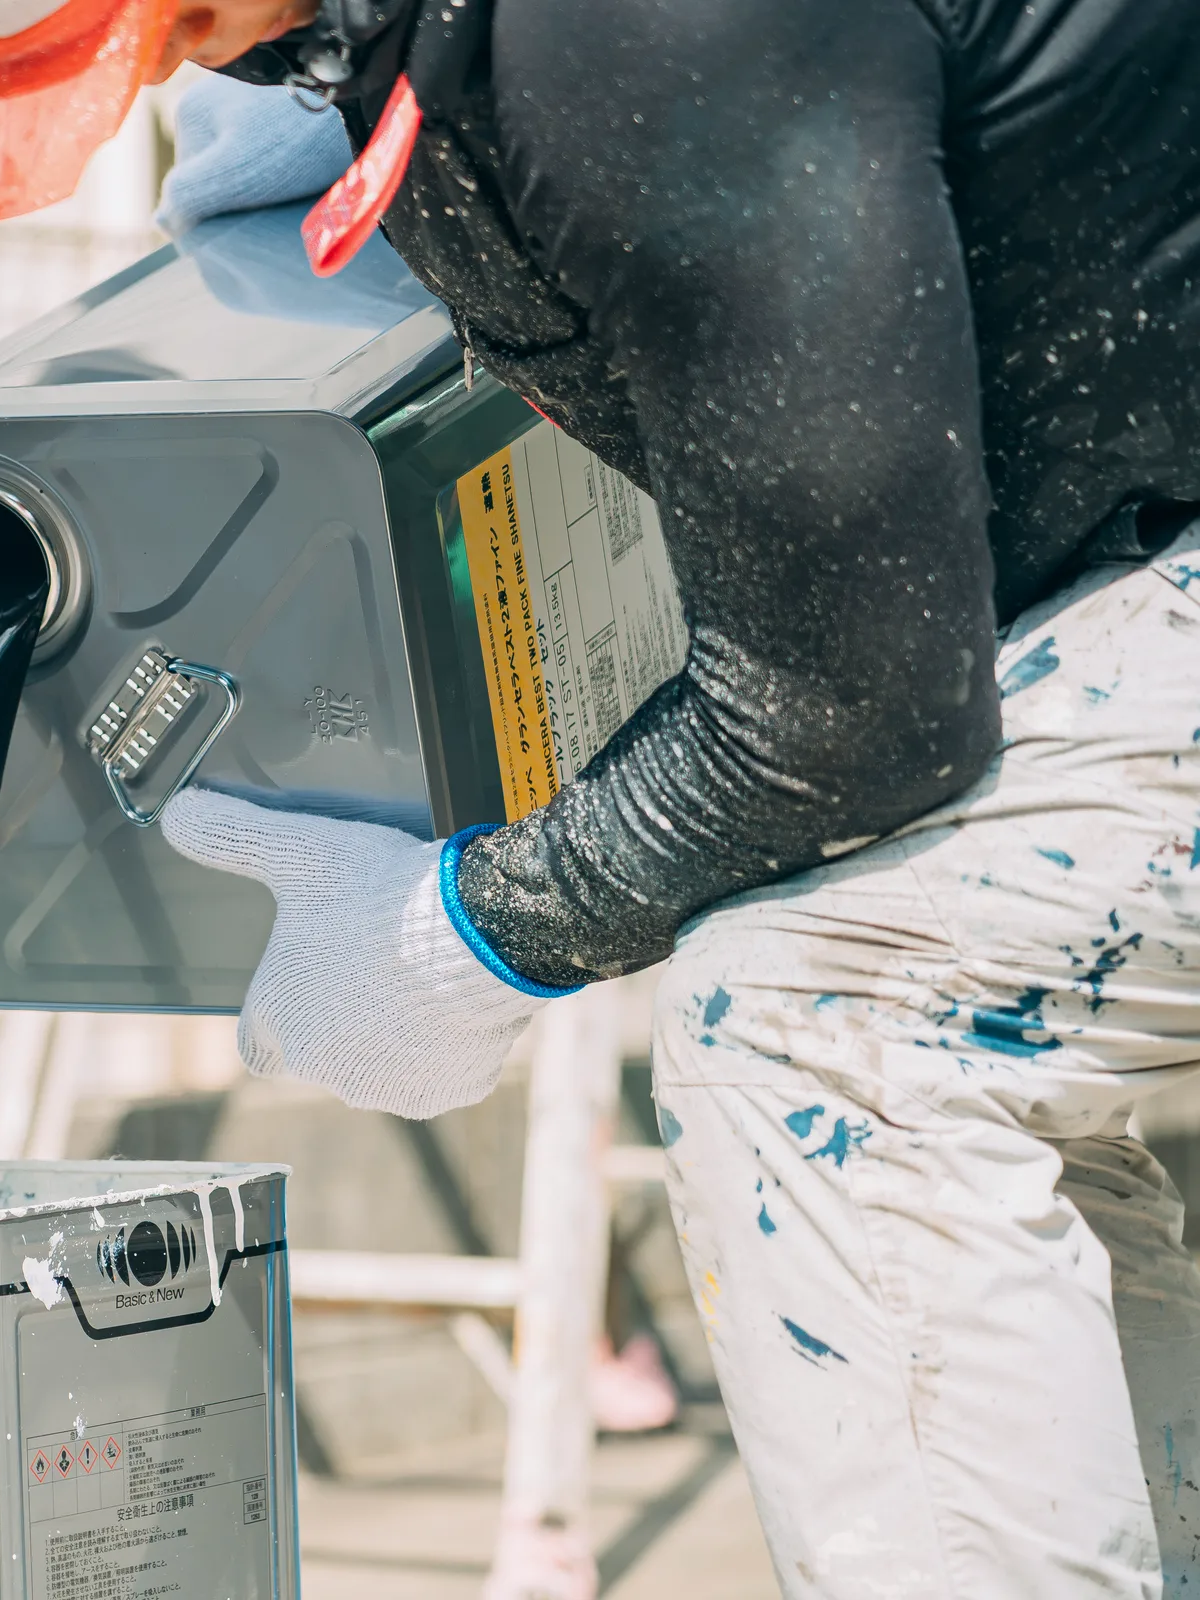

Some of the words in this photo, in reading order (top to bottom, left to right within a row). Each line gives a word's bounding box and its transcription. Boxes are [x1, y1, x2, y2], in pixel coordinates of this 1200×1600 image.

[479, 470, 494, 513] 遮熱
[501, 462, 519, 545] SHANETSU
[513, 549, 524, 584] FINE
[519, 587, 531, 631] PACK
[548, 581, 563, 631] 13.5kg
[487, 524, 529, 755] グランセラベスト2液ファイン
[526, 634, 537, 670] TWO
[534, 616, 549, 665] セット
[532, 673, 544, 713] BEST
[555, 642, 572, 703] ST-05
[539, 716, 557, 798] GRANCERA
[115, 1291, 147, 1309] Basic
[148, 1290, 156, 1304] &
[156, 1285, 184, 1302] New
[117, 1493, 194, 1521] 安全衛生上の注意事項
